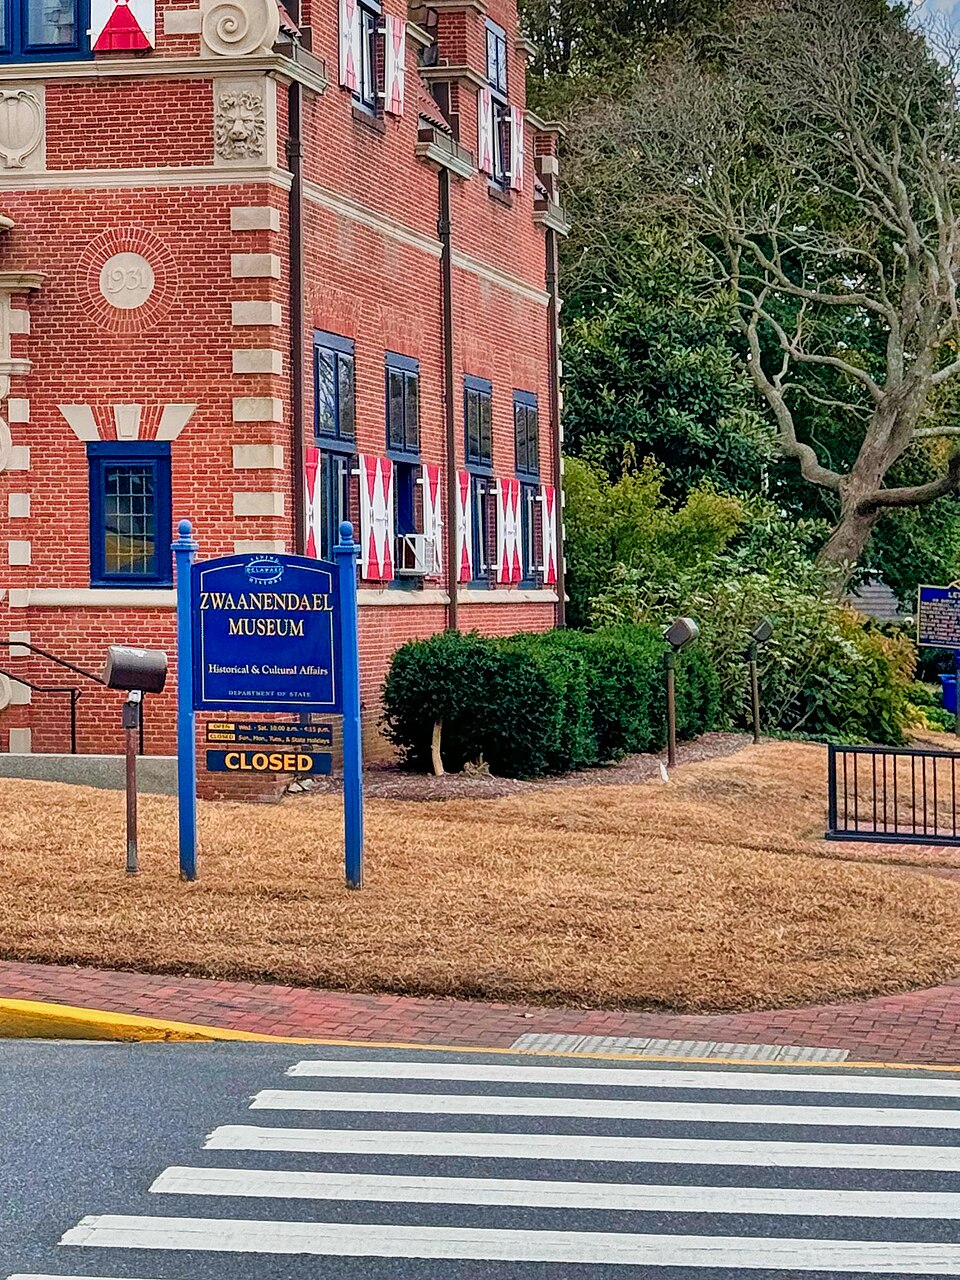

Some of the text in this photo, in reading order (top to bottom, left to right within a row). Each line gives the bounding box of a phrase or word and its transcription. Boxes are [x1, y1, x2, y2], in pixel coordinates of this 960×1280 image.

[106, 267, 147, 294] 1931
[249, 577, 282, 585] HISTORY
[199, 592, 334, 611] ZWAANENDAEL
[228, 617, 305, 636] MUSEUM
[208, 664, 328, 675] Historical & Cultural Affairs
[224, 752, 313, 772] CLOSED
